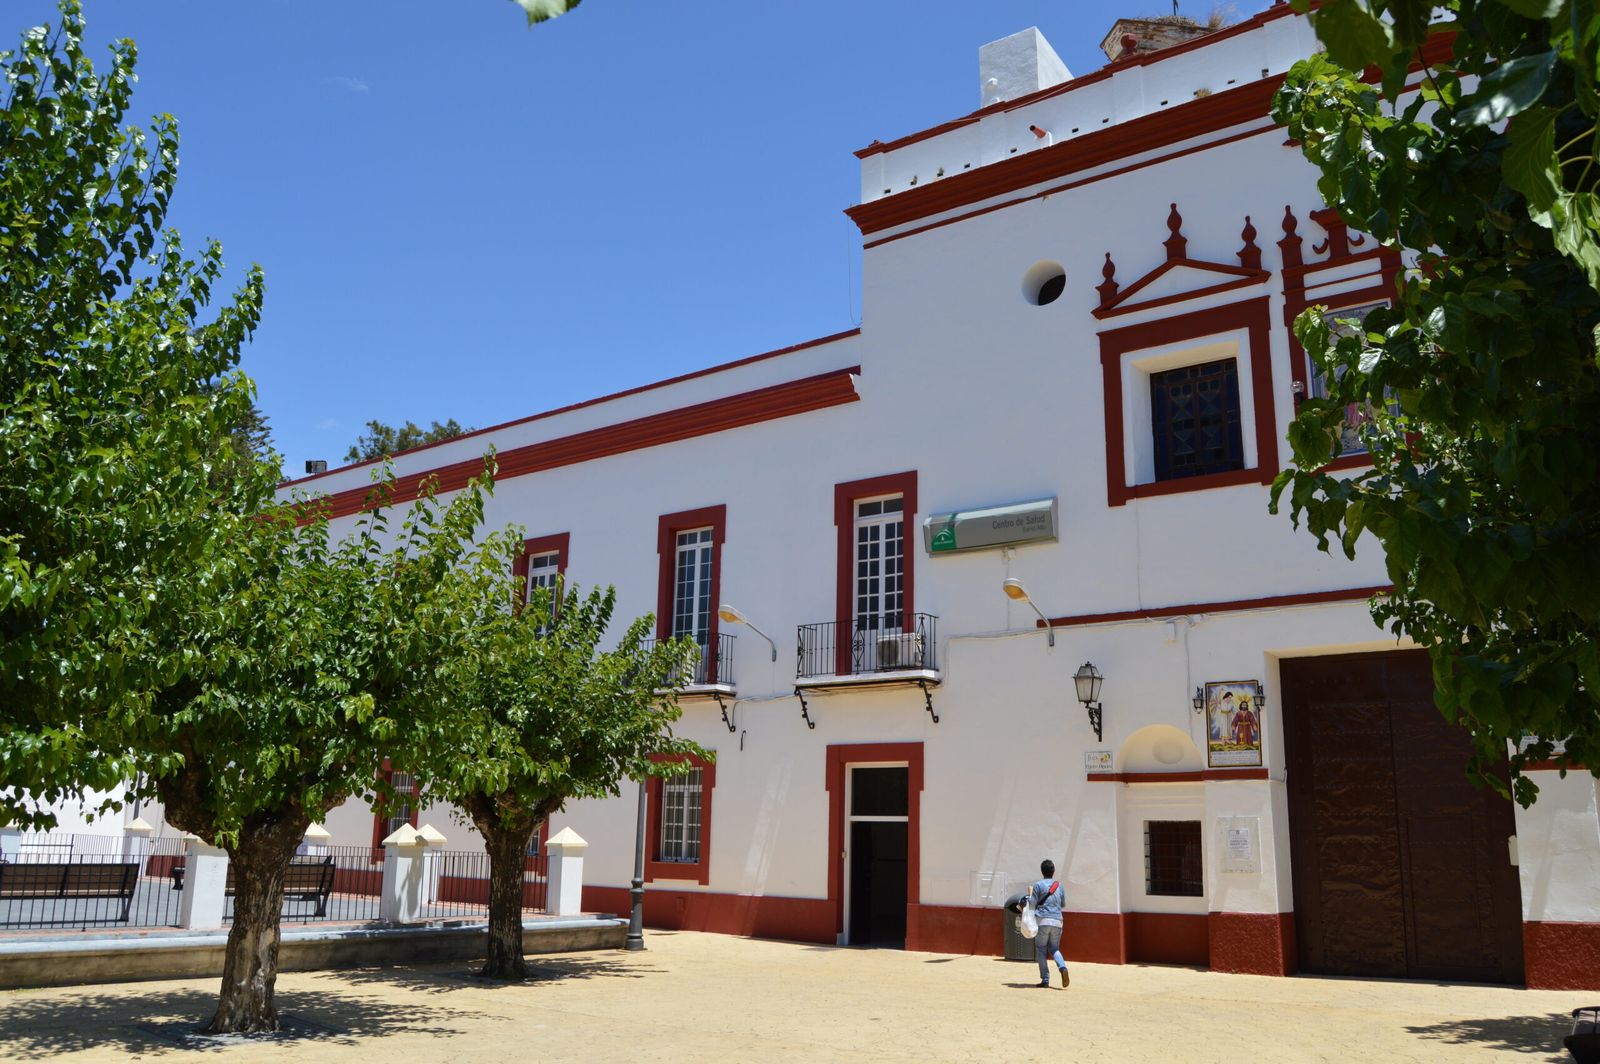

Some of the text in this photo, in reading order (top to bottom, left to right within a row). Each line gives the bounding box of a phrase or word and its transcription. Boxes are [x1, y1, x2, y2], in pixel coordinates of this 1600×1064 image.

[992, 520, 1014, 529] Centro
[1015, 517, 1024, 526] de
[1025, 513, 1046, 525] Salud
